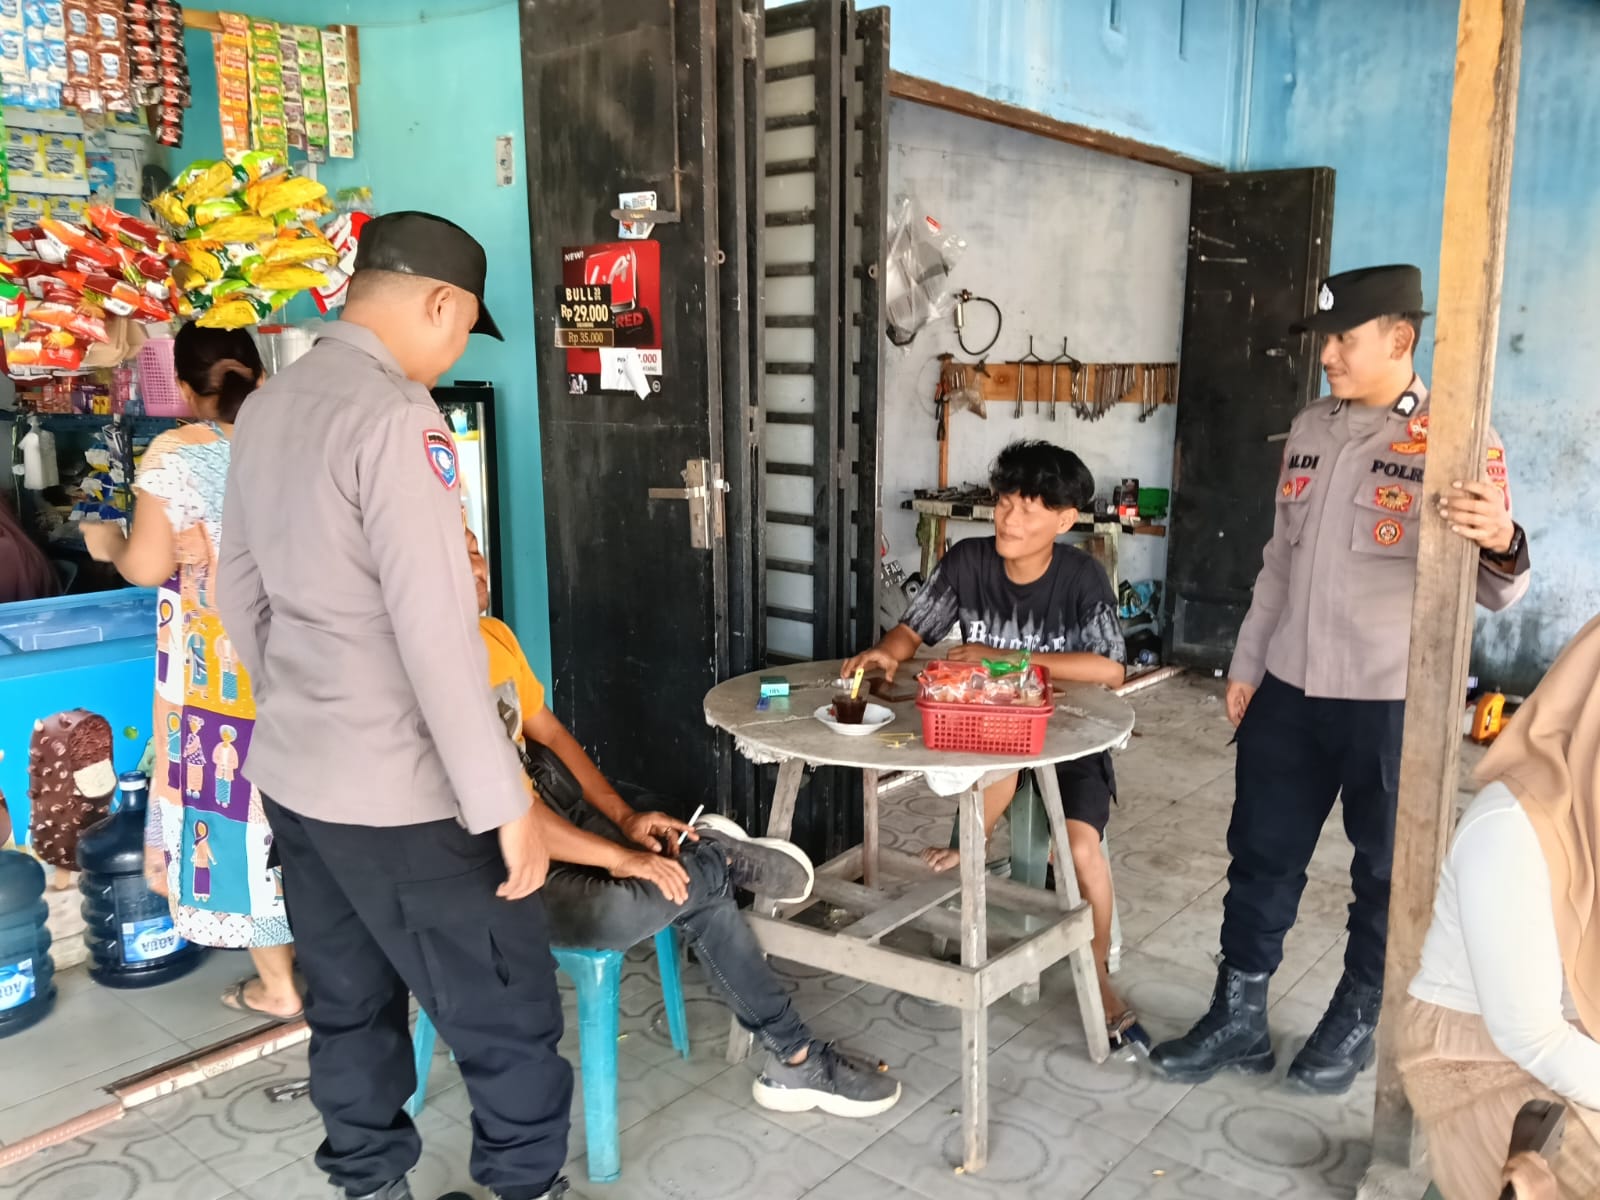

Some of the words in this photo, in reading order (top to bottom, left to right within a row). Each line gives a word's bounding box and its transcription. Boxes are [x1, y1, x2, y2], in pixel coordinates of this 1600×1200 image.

[564, 250, 584, 263] NEW!
[565, 287, 593, 301] BULL
[561, 304, 573, 321] Rp
[573, 304, 609, 322] 29.000
[616, 312, 644, 328] RED
[568, 332, 578, 345] Rp
[580, 332, 604, 344] 35.000
[638, 353, 657, 363] .000
[1370, 459, 1424, 483] POLR
[141, 935, 175, 953] AQUA
[0, 981, 22, 998] AQ
